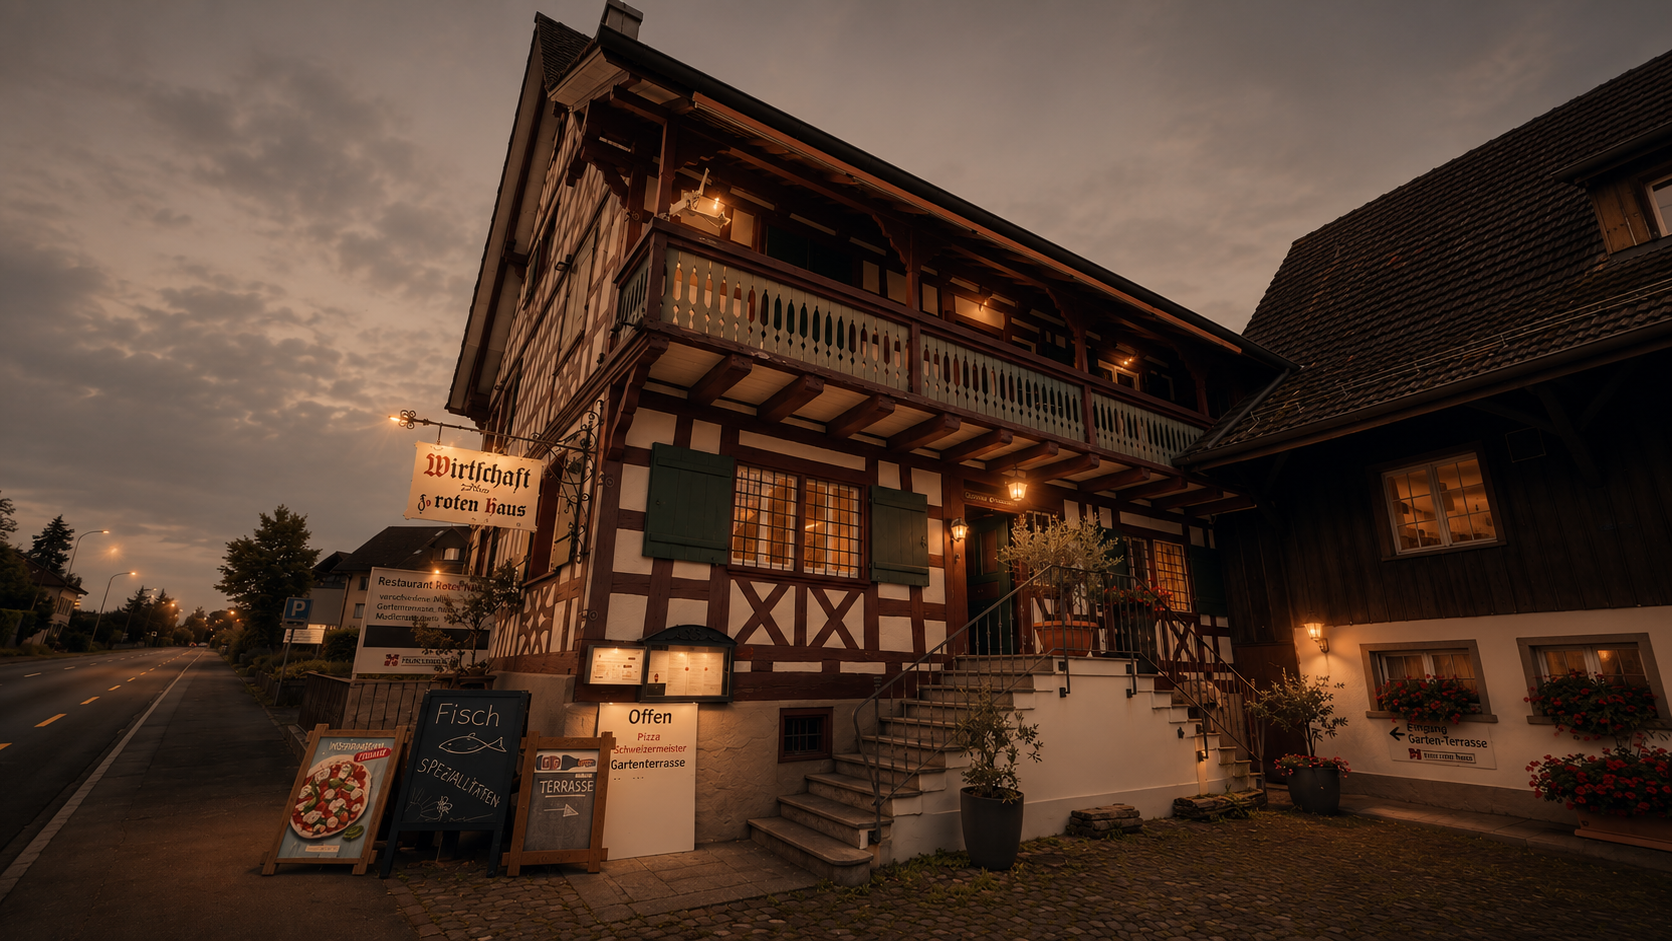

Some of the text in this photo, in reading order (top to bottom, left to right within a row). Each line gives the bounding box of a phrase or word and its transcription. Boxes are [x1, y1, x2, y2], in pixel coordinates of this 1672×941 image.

[378, 576, 433, 590] Restaurant
[291, 600, 306, 617] P
[435, 703, 500, 727] Fisch
[628, 708, 672, 725] Offen
[637, 732, 661, 741] Pizza
[1408, 734, 1488, 748] Garten-Terrasse
[613, 744, 687, 754] Schweizermeister
[611, 758, 686, 770] Gartenterrasse
[539, 780, 594, 794] TERRASSE
